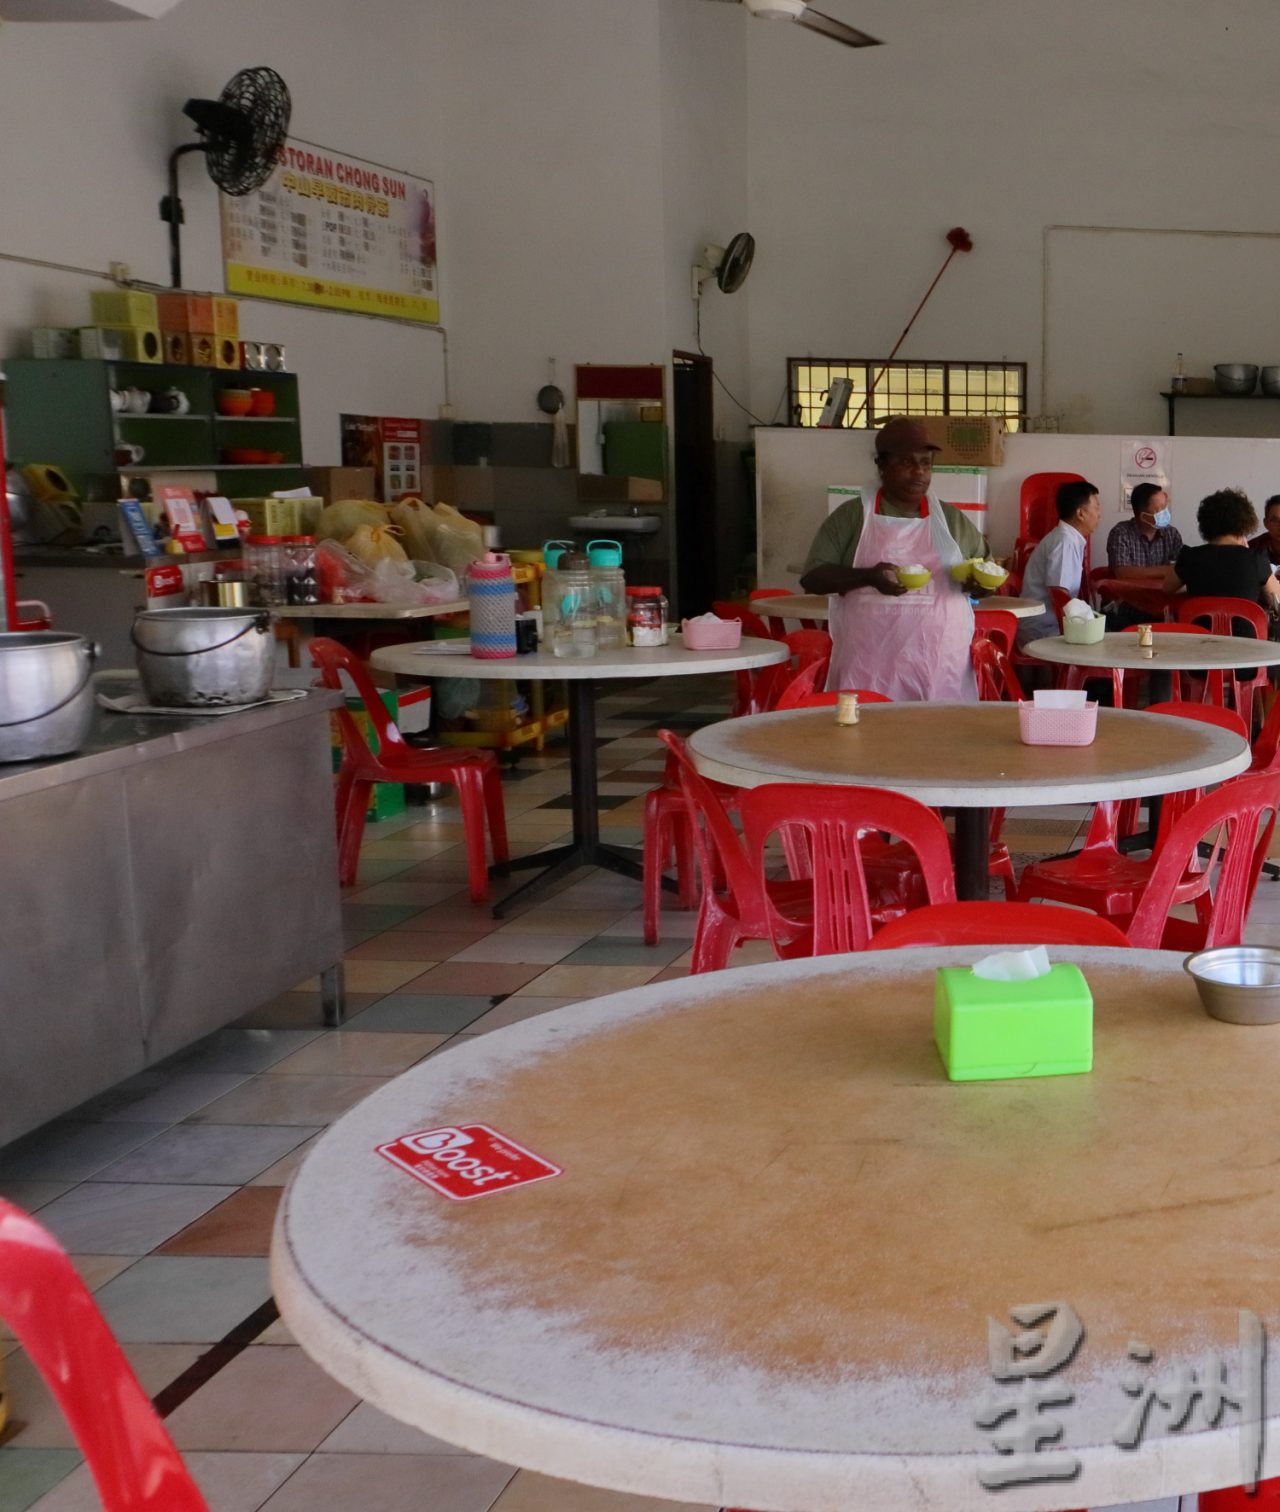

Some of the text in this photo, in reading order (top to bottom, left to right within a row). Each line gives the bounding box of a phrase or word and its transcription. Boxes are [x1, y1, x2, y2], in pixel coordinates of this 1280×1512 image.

[336, 162, 380, 194] CHONG
[382, 177, 406, 200] SUN
[399, 1127, 513, 1187] Boost
